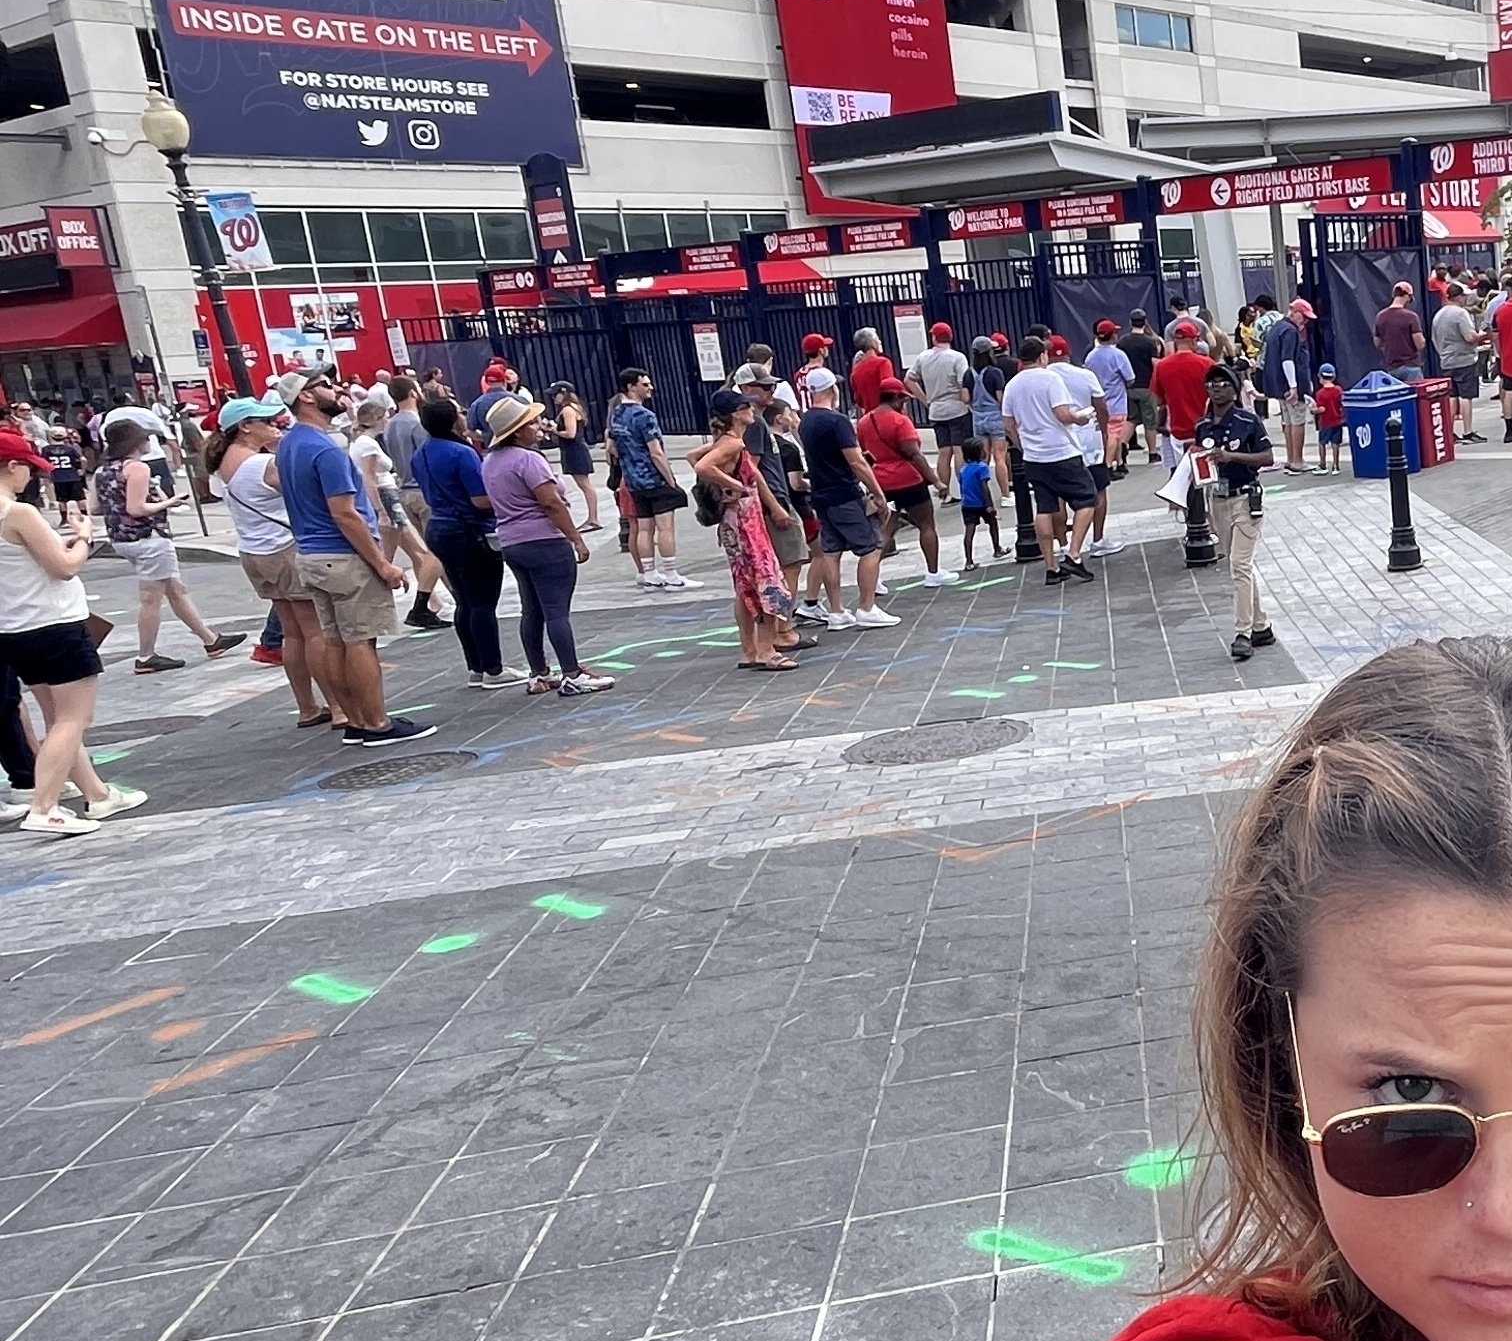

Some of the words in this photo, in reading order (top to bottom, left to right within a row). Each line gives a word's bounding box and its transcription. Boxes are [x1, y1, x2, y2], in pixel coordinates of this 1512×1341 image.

[889, 13, 930, 27] cocaine
[180, 6, 286, 38] INSIDE
[292, 16, 368, 45] GATE
[376, 24, 417, 49] ON
[422, 29, 474, 56] THE
[480, 32, 538, 59] LEFT
[891, 28, 913, 42] pills
[892, 44, 928, 60] heroin
[280, 70, 323, 88] FOR
[326, 73, 388, 92] STORE
[391, 76, 454, 95] HOURS
[456, 80, 490, 98] SEE
[303, 92, 477, 116] @NATSTEAMSTORE
[837, 94, 856, 108] BE
[1472, 156, 1506, 175] THIRD
[1234, 170, 1288, 191] ADDITIONAL
[1290, 166, 1320, 184] GATES
[1321, 165, 1334, 180] AT
[1235, 189, 1264, 205] RIGHT
[1265, 186, 1293, 201] FIELD
[1295, 183, 1314, 199] AND
[1315, 180, 1343, 197] FIRST
[1345, 177, 1371, 194] BASE
[966, 209, 999, 223] WELCOME
[999, 207, 1009, 219] TO
[1005, 216, 1024, 229] PARK
[60, 220, 88, 234] BOX
[57, 235, 100, 250] OFFICE
[1431, 402, 1446, 462] TRASH
